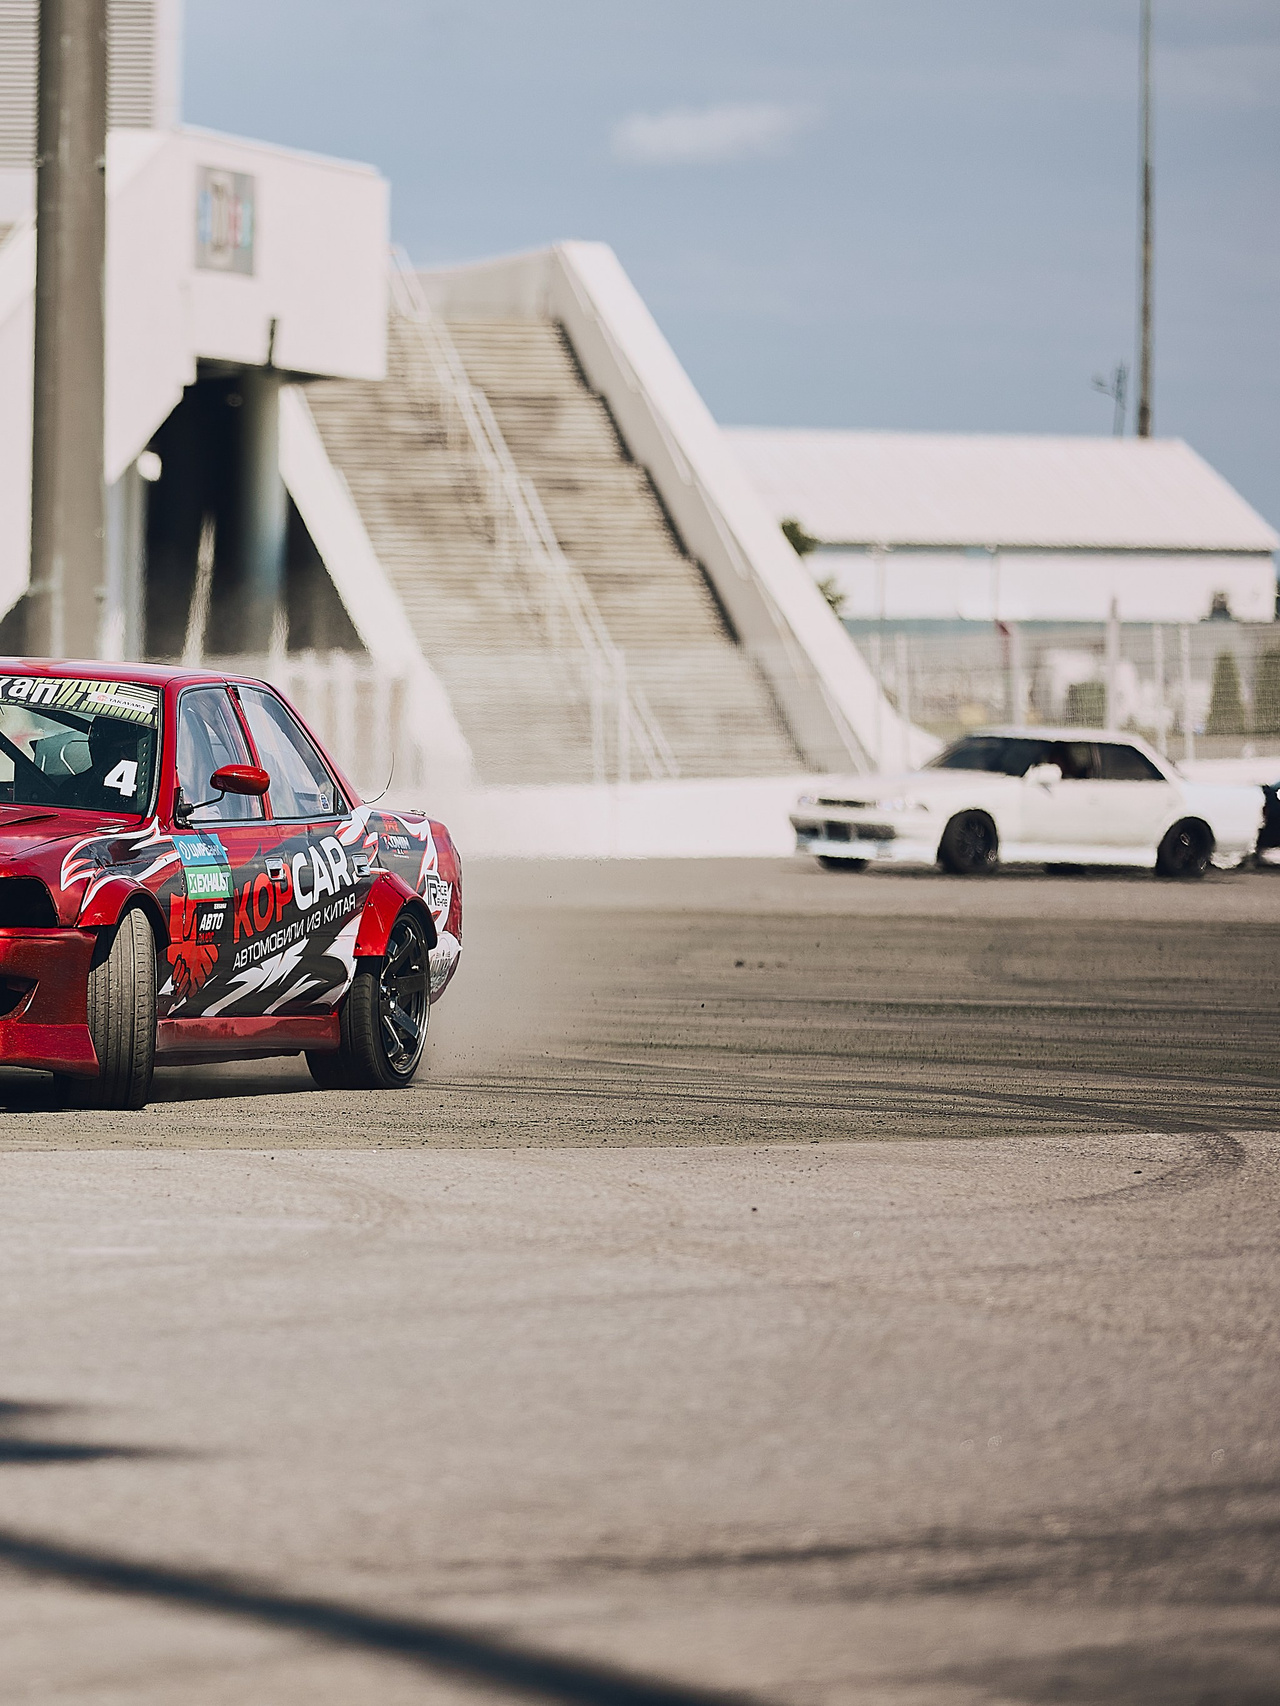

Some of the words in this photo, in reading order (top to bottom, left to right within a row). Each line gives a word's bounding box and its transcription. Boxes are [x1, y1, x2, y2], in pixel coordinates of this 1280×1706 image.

[103, 759, 138, 797] 4
[199, 912, 224, 931] АВТО
[232, 918, 305, 971] АВТОМОБИЛИ
[306, 910, 321, 933] ИЗ
[323, 892, 356, 925] КИТАЯ
